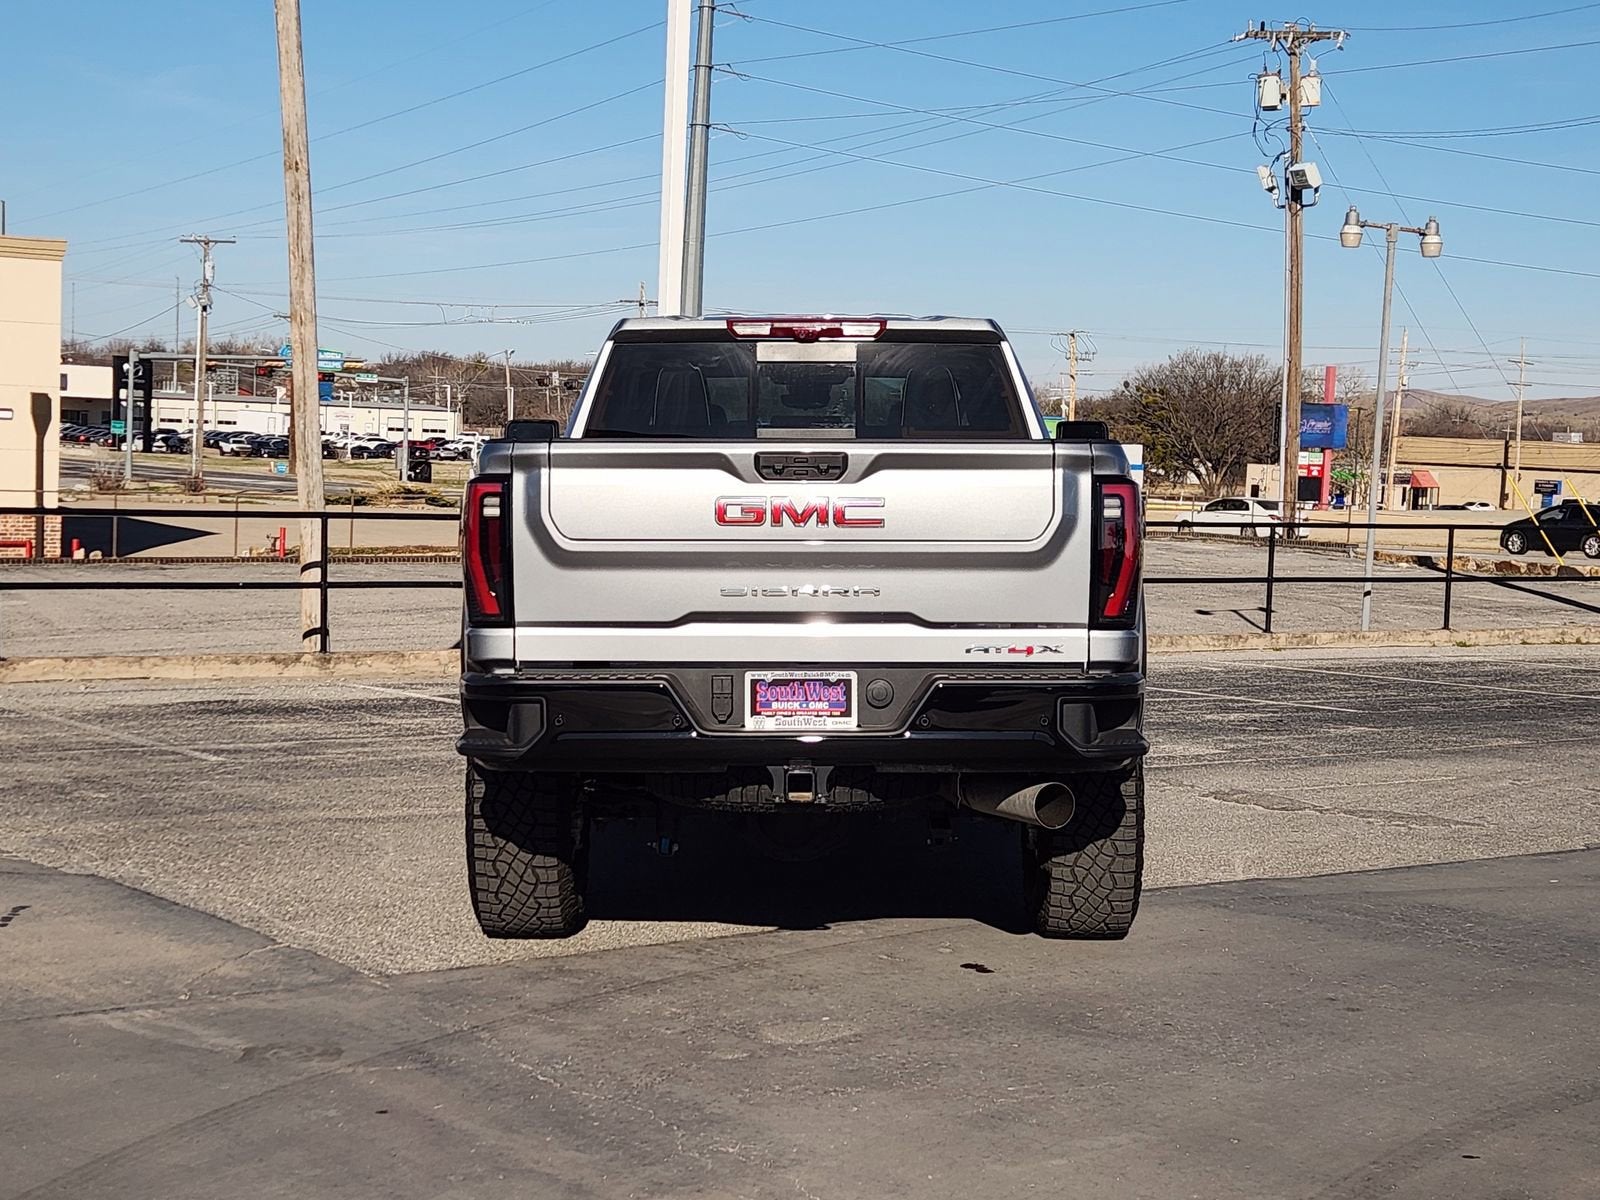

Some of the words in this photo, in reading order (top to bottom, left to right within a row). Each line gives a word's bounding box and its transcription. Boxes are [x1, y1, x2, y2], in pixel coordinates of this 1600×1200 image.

[714, 495, 886, 528] GMC
[719, 585, 881, 598] SIERRA
[965, 643, 1065, 657] AT4X
[771, 701, 800, 709] BUICK
[808, 701, 830, 709] GMC
